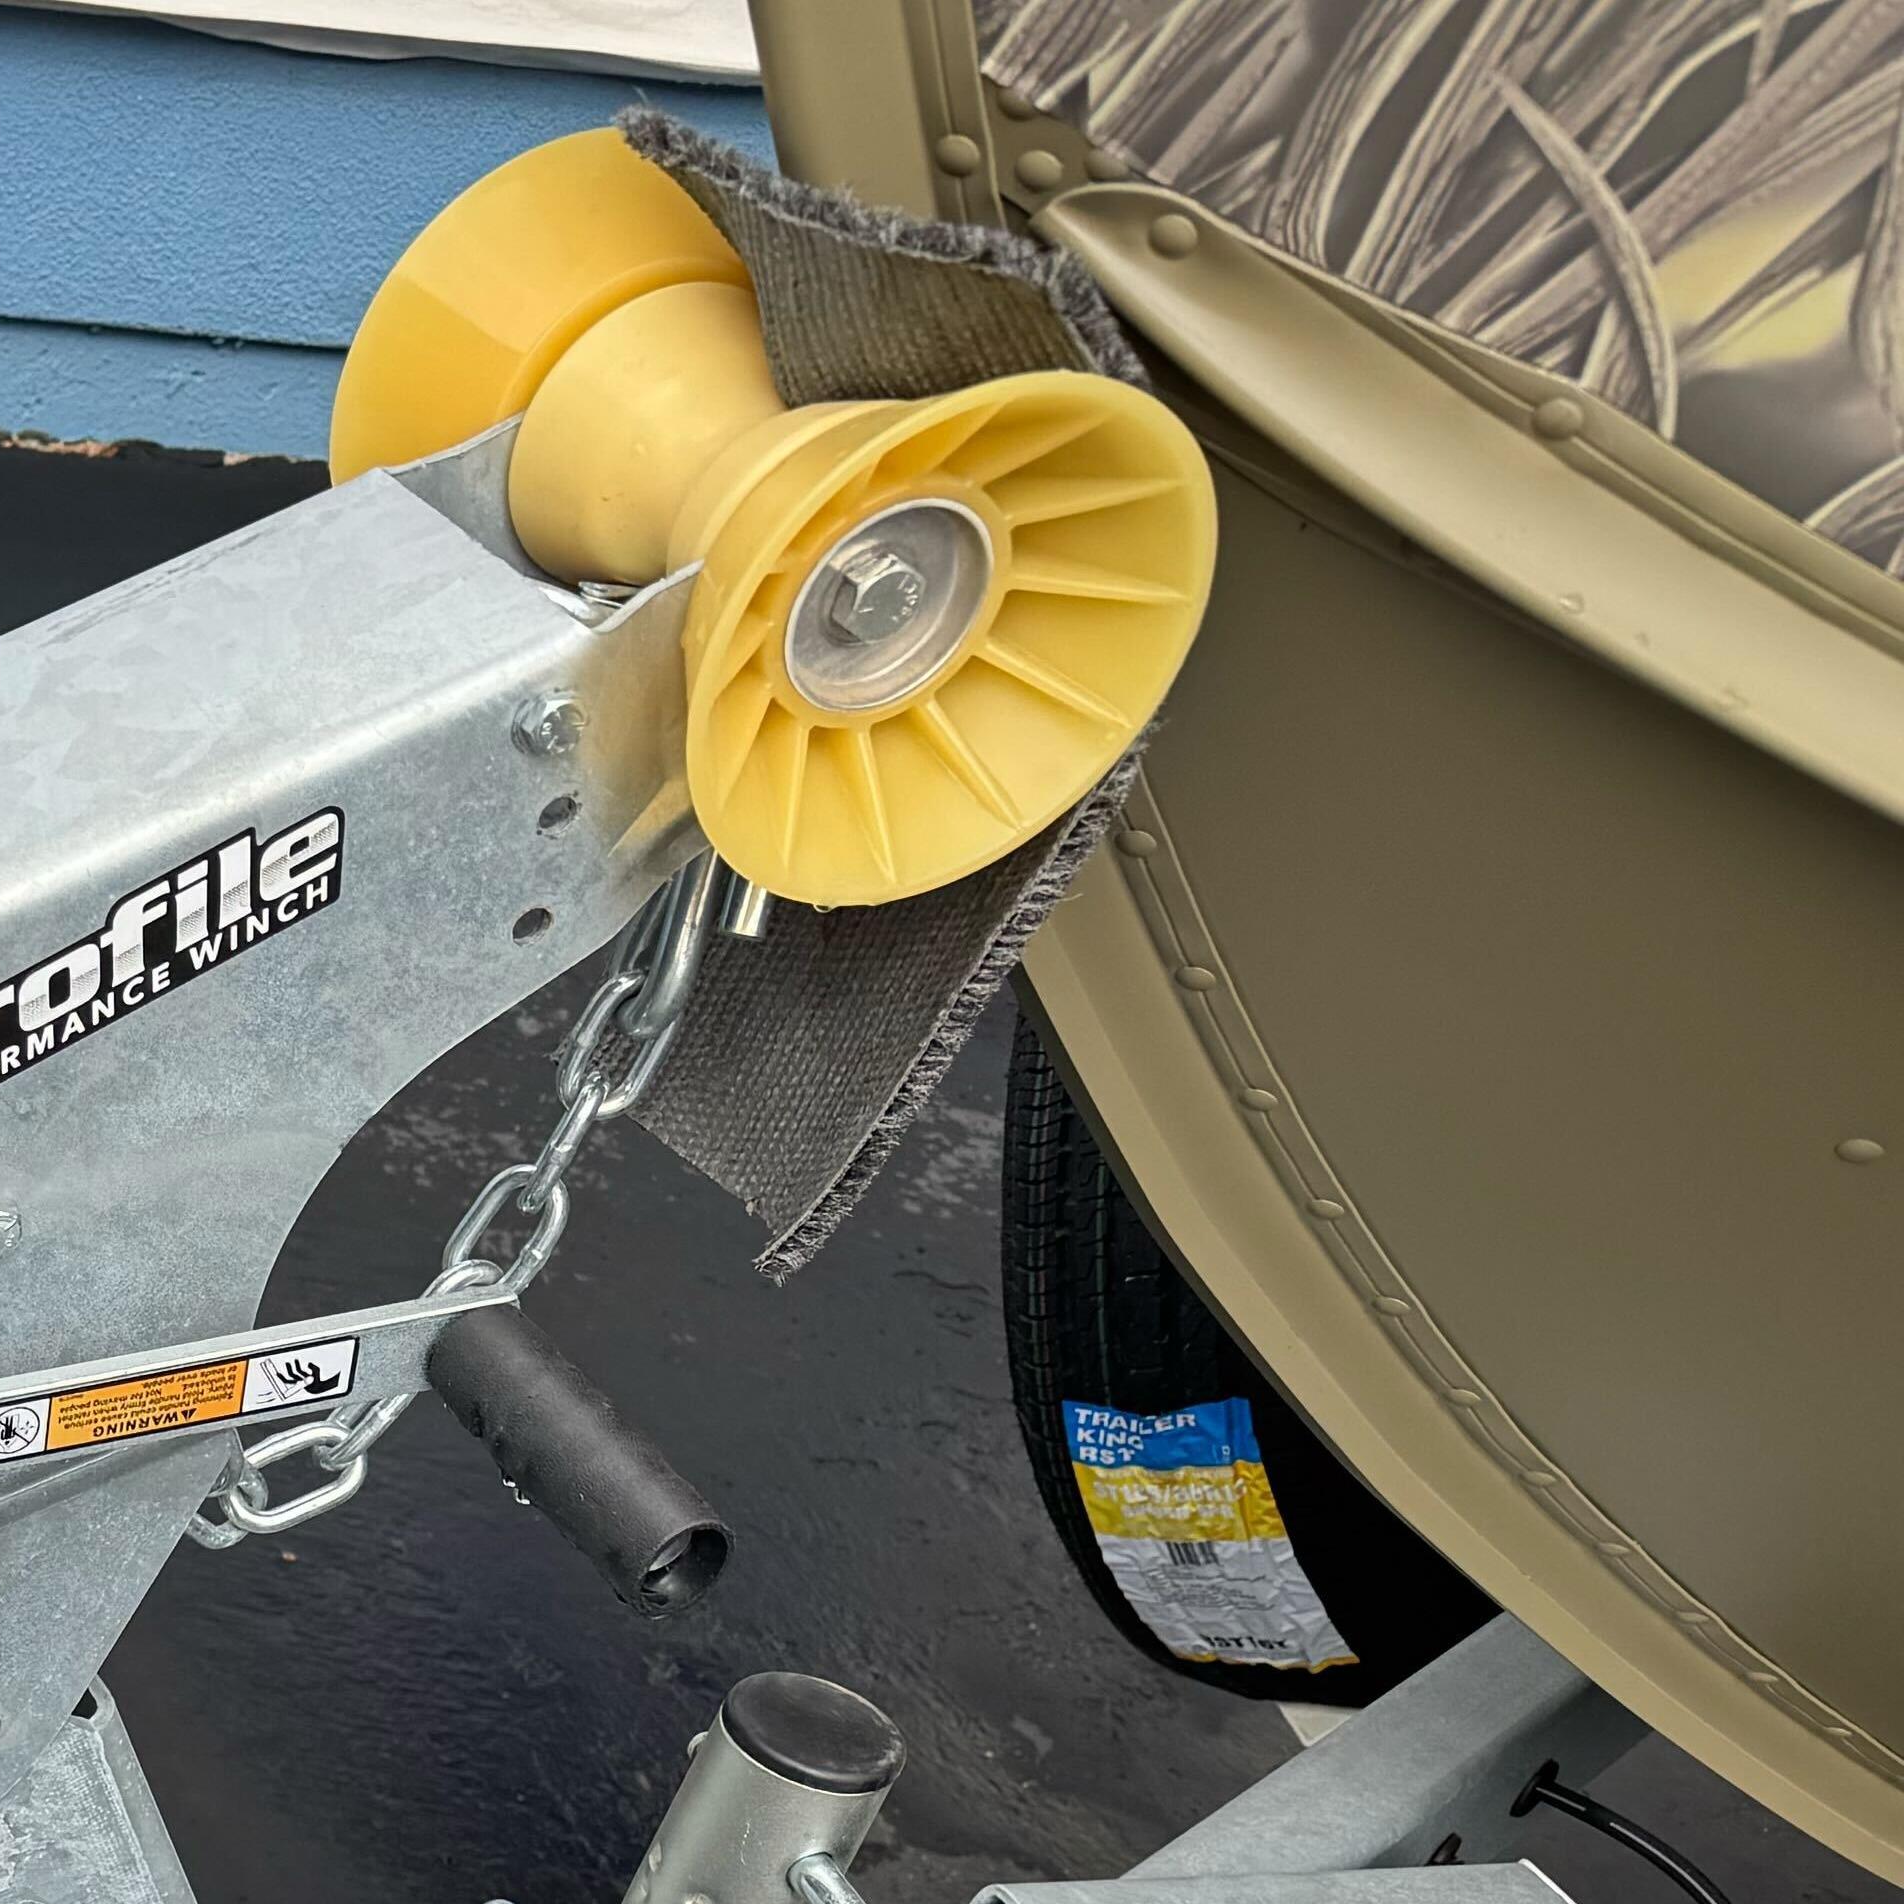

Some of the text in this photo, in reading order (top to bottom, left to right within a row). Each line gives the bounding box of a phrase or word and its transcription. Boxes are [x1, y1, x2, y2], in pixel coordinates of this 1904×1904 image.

[189, 876, 328, 970] WINCH
[176, 1373, 196, 1381] over
[130, 1392, 142, 1400] for
[145, 1388, 161, 1397] Not
[93, 1394, 126, 1406] moving
[149, 1394, 179, 1405] handle
[59, 1401, 89, 1412] people
[93, 1406, 117, 1415] when
[159, 1401, 189, 1411] handle
[58, 1411, 89, 1423] ratchet
[101, 1412, 126, 1422] cause
[131, 1407, 155, 1417] could
[93, 1412, 177, 1437] WARNING
[1075, 1408, 1196, 1434] TRAILER
[1077, 1428, 1144, 1450] KING
[1079, 1446, 1136, 1465] RST
